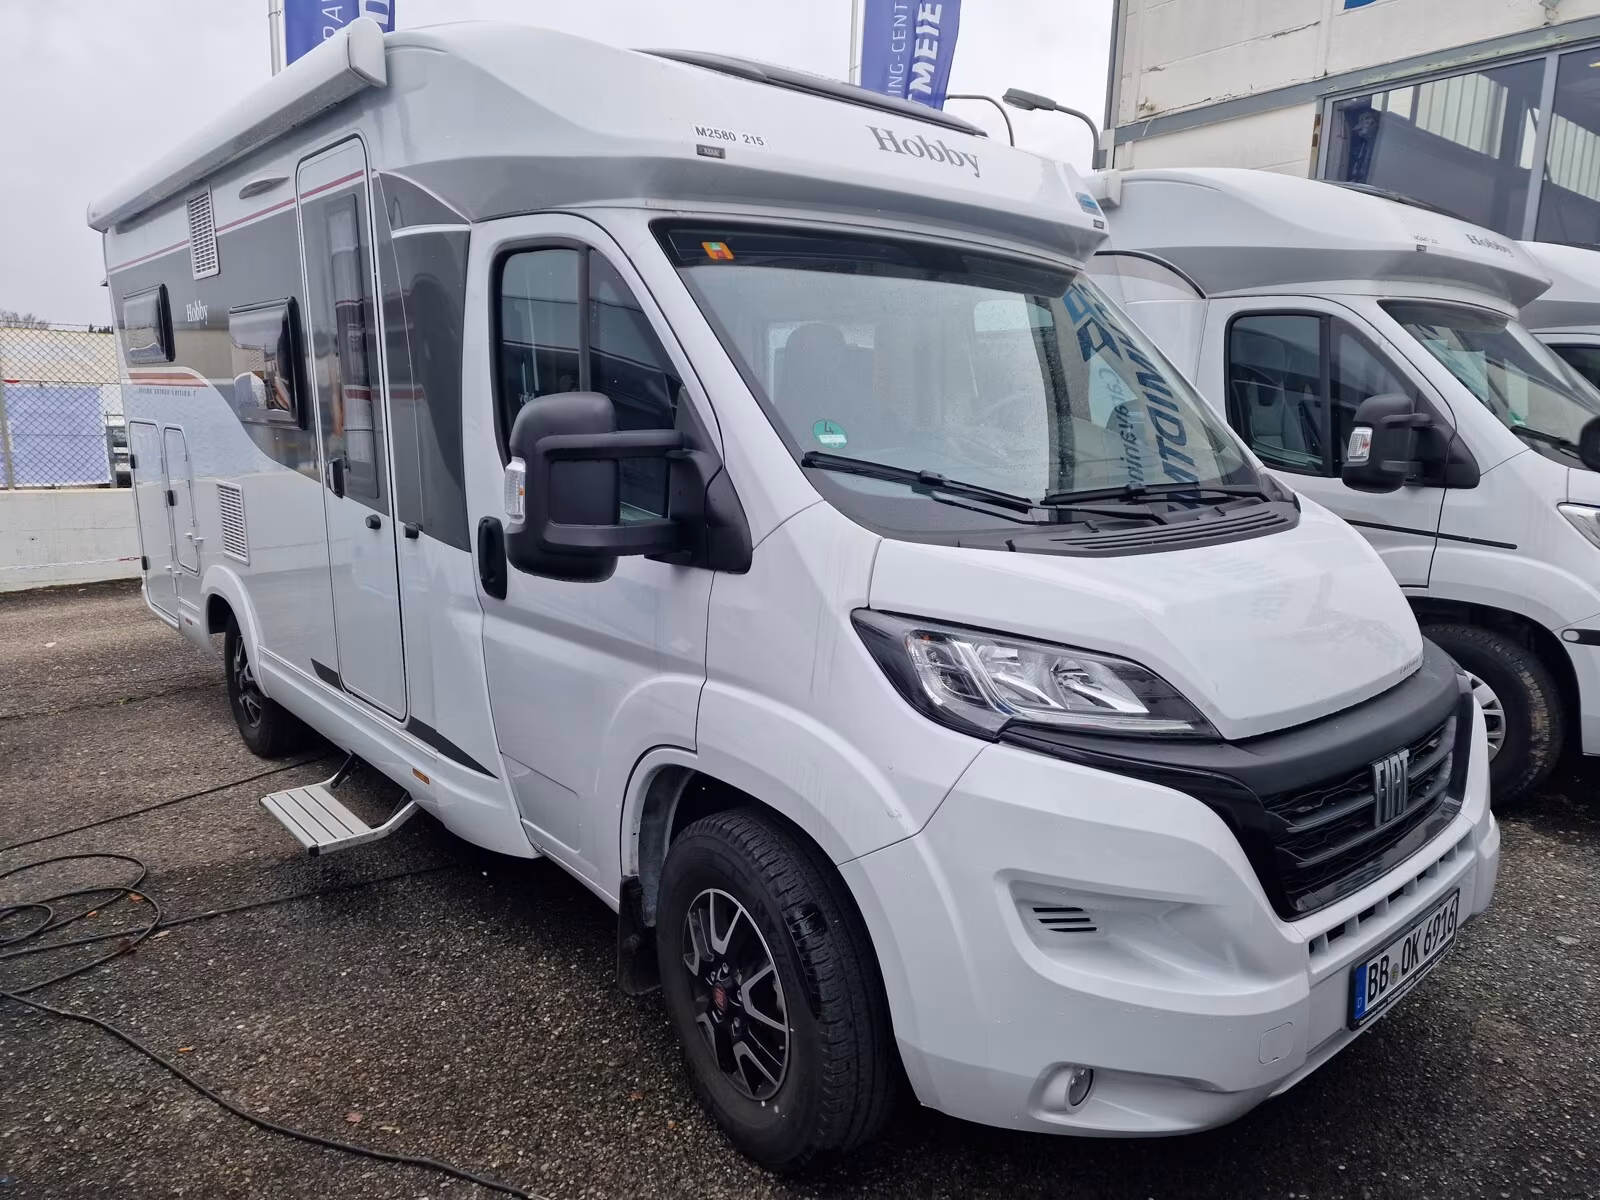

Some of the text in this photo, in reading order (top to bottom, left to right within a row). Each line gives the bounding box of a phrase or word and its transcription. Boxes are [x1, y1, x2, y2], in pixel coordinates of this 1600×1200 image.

[907, 3, 942, 101] MEIE
[695, 125, 764, 146] M2580 215
[865, 124, 980, 178] Hobby
[185, 299, 208, 325] Hobby
[1373, 748, 1410, 828] FIAT
[1367, 954, 1390, 1004] BB
[1401, 927, 1422, 976] OK
[1423, 897, 1457, 957] 6916
